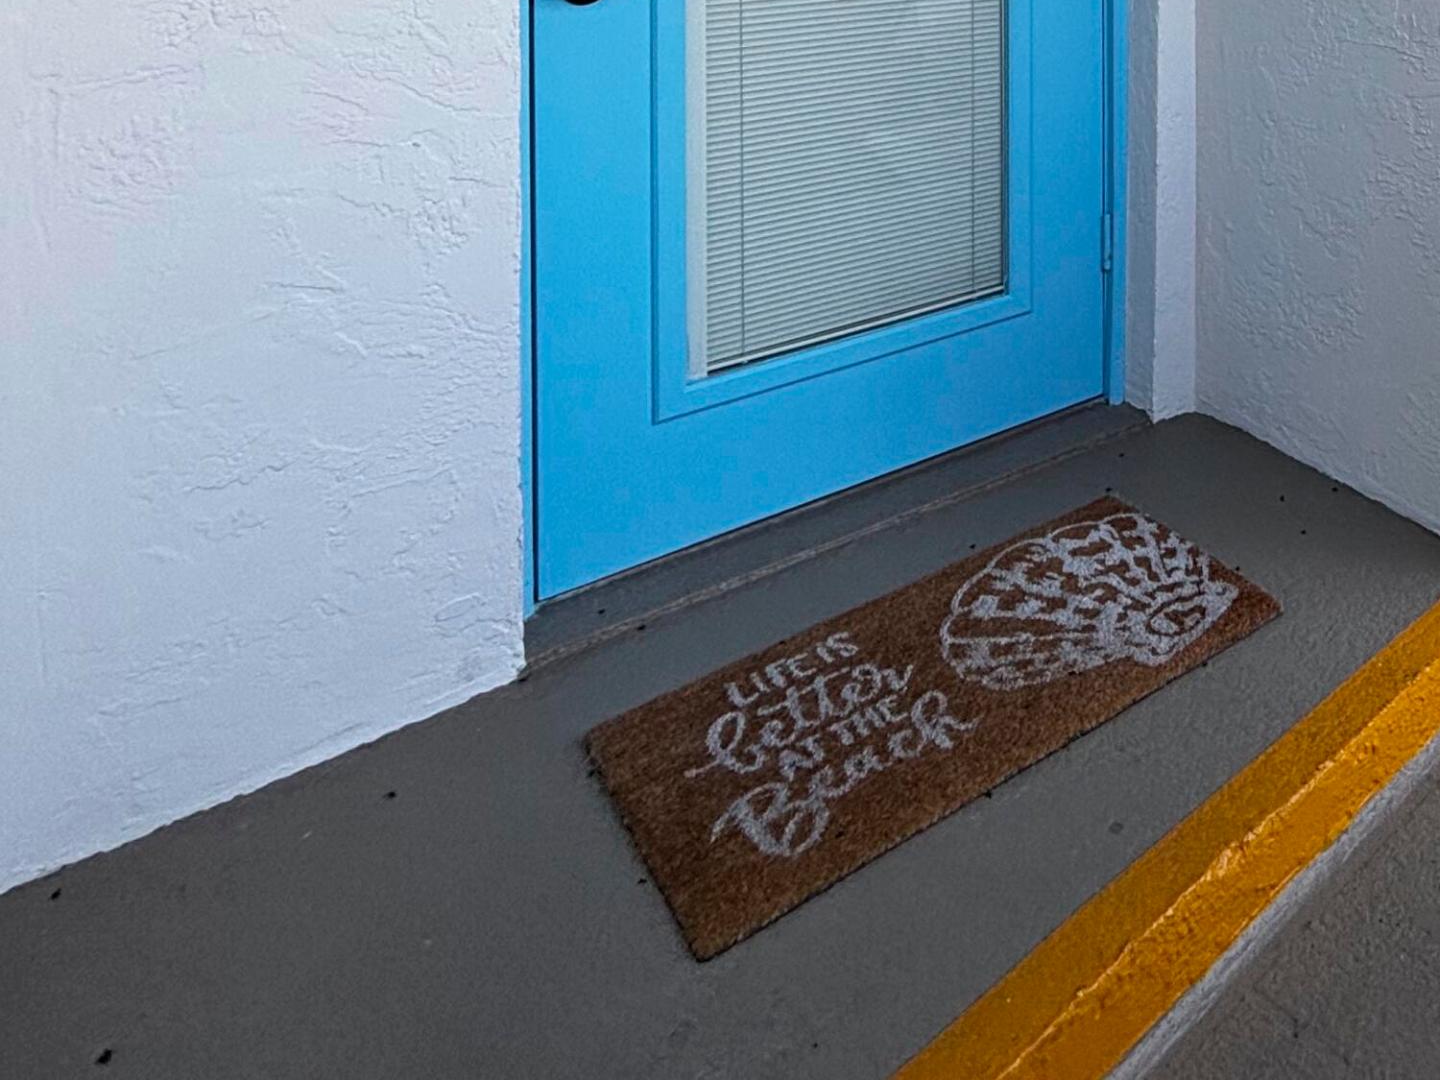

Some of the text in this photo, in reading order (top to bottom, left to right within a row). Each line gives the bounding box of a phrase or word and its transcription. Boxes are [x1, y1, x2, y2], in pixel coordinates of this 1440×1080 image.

[724, 631, 859, 708] LIFE IS
[779, 695, 908, 781] AT THE
